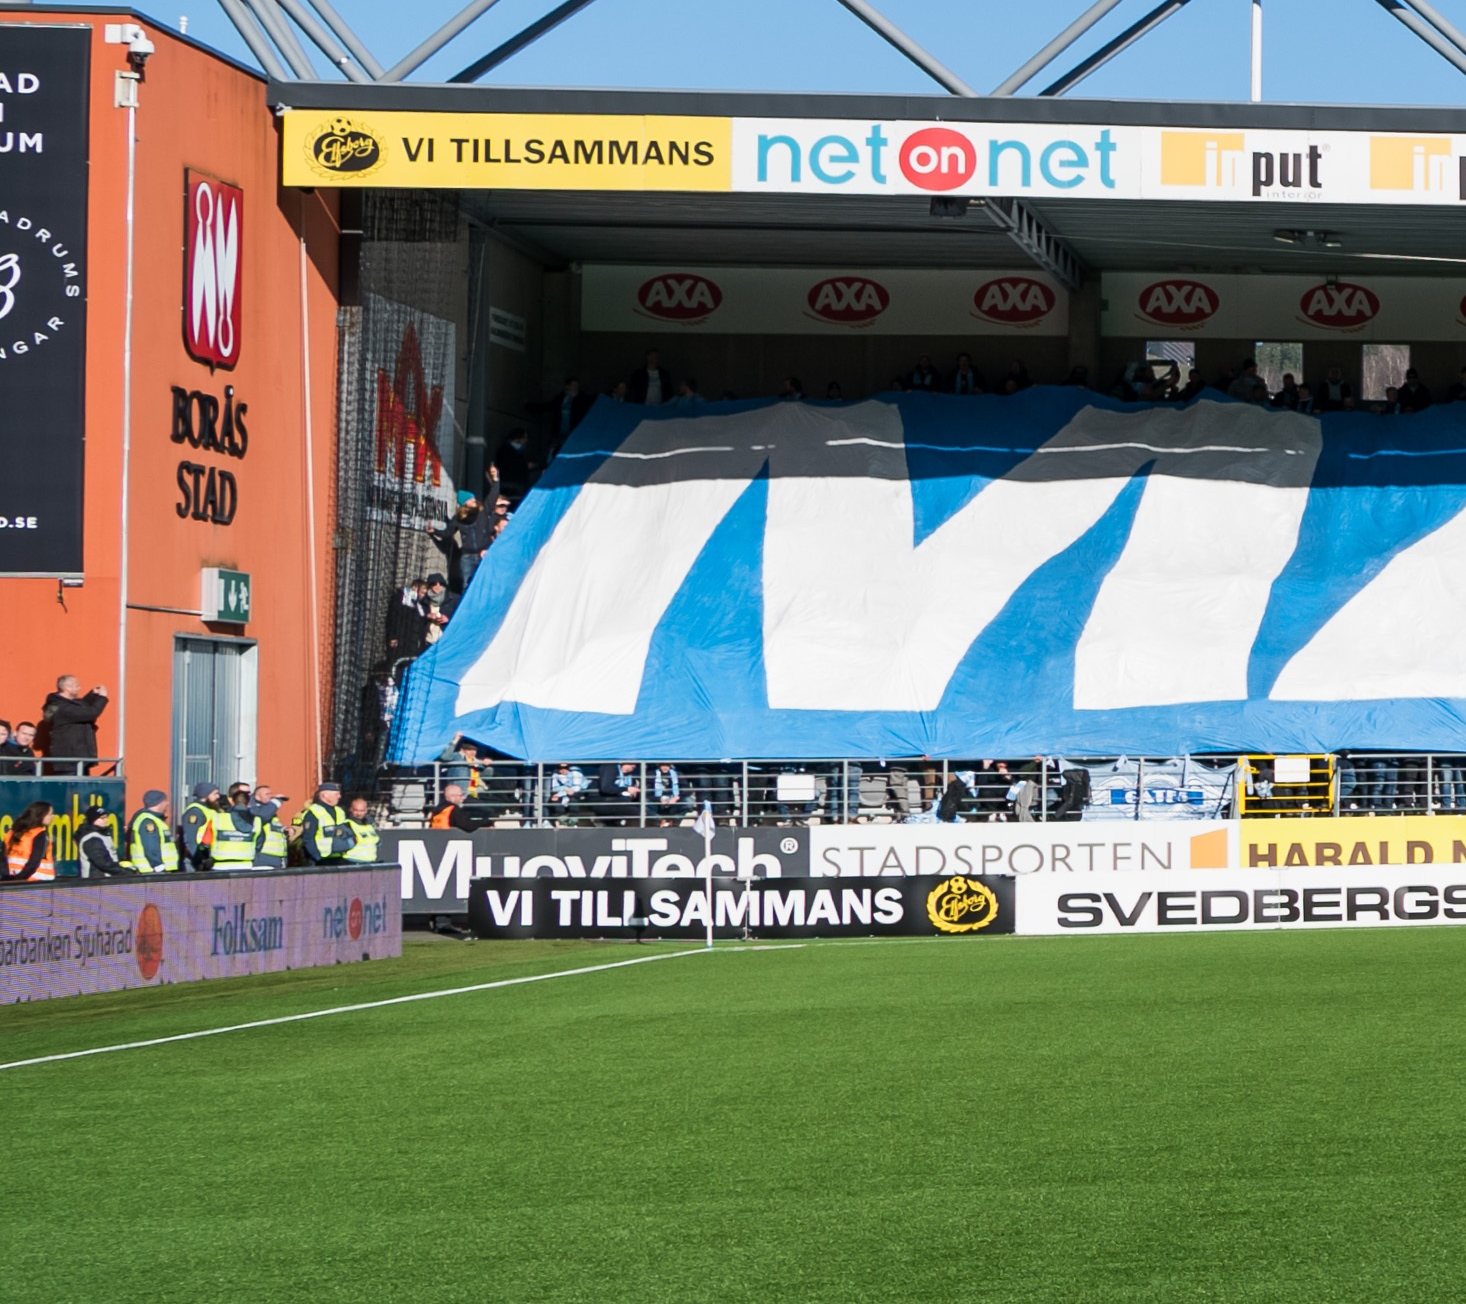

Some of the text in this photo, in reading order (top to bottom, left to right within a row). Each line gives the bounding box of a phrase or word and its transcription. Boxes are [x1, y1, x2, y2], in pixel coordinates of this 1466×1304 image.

[401, 137, 714, 166] VI TILLSAMMANS
[757, 124, 1117, 189] net on net
[645, 280, 715, 309] AXA
[170, 385, 248, 460] BORÅS
[176, 460, 238, 525] STAD
[822, 842, 1172, 877] STADSPORTEN
[486, 887, 904, 927] VI TILLSAMMANS
[74, 925, 132, 967] Sjuhärad
[211, 903, 283, 957] Folksam
